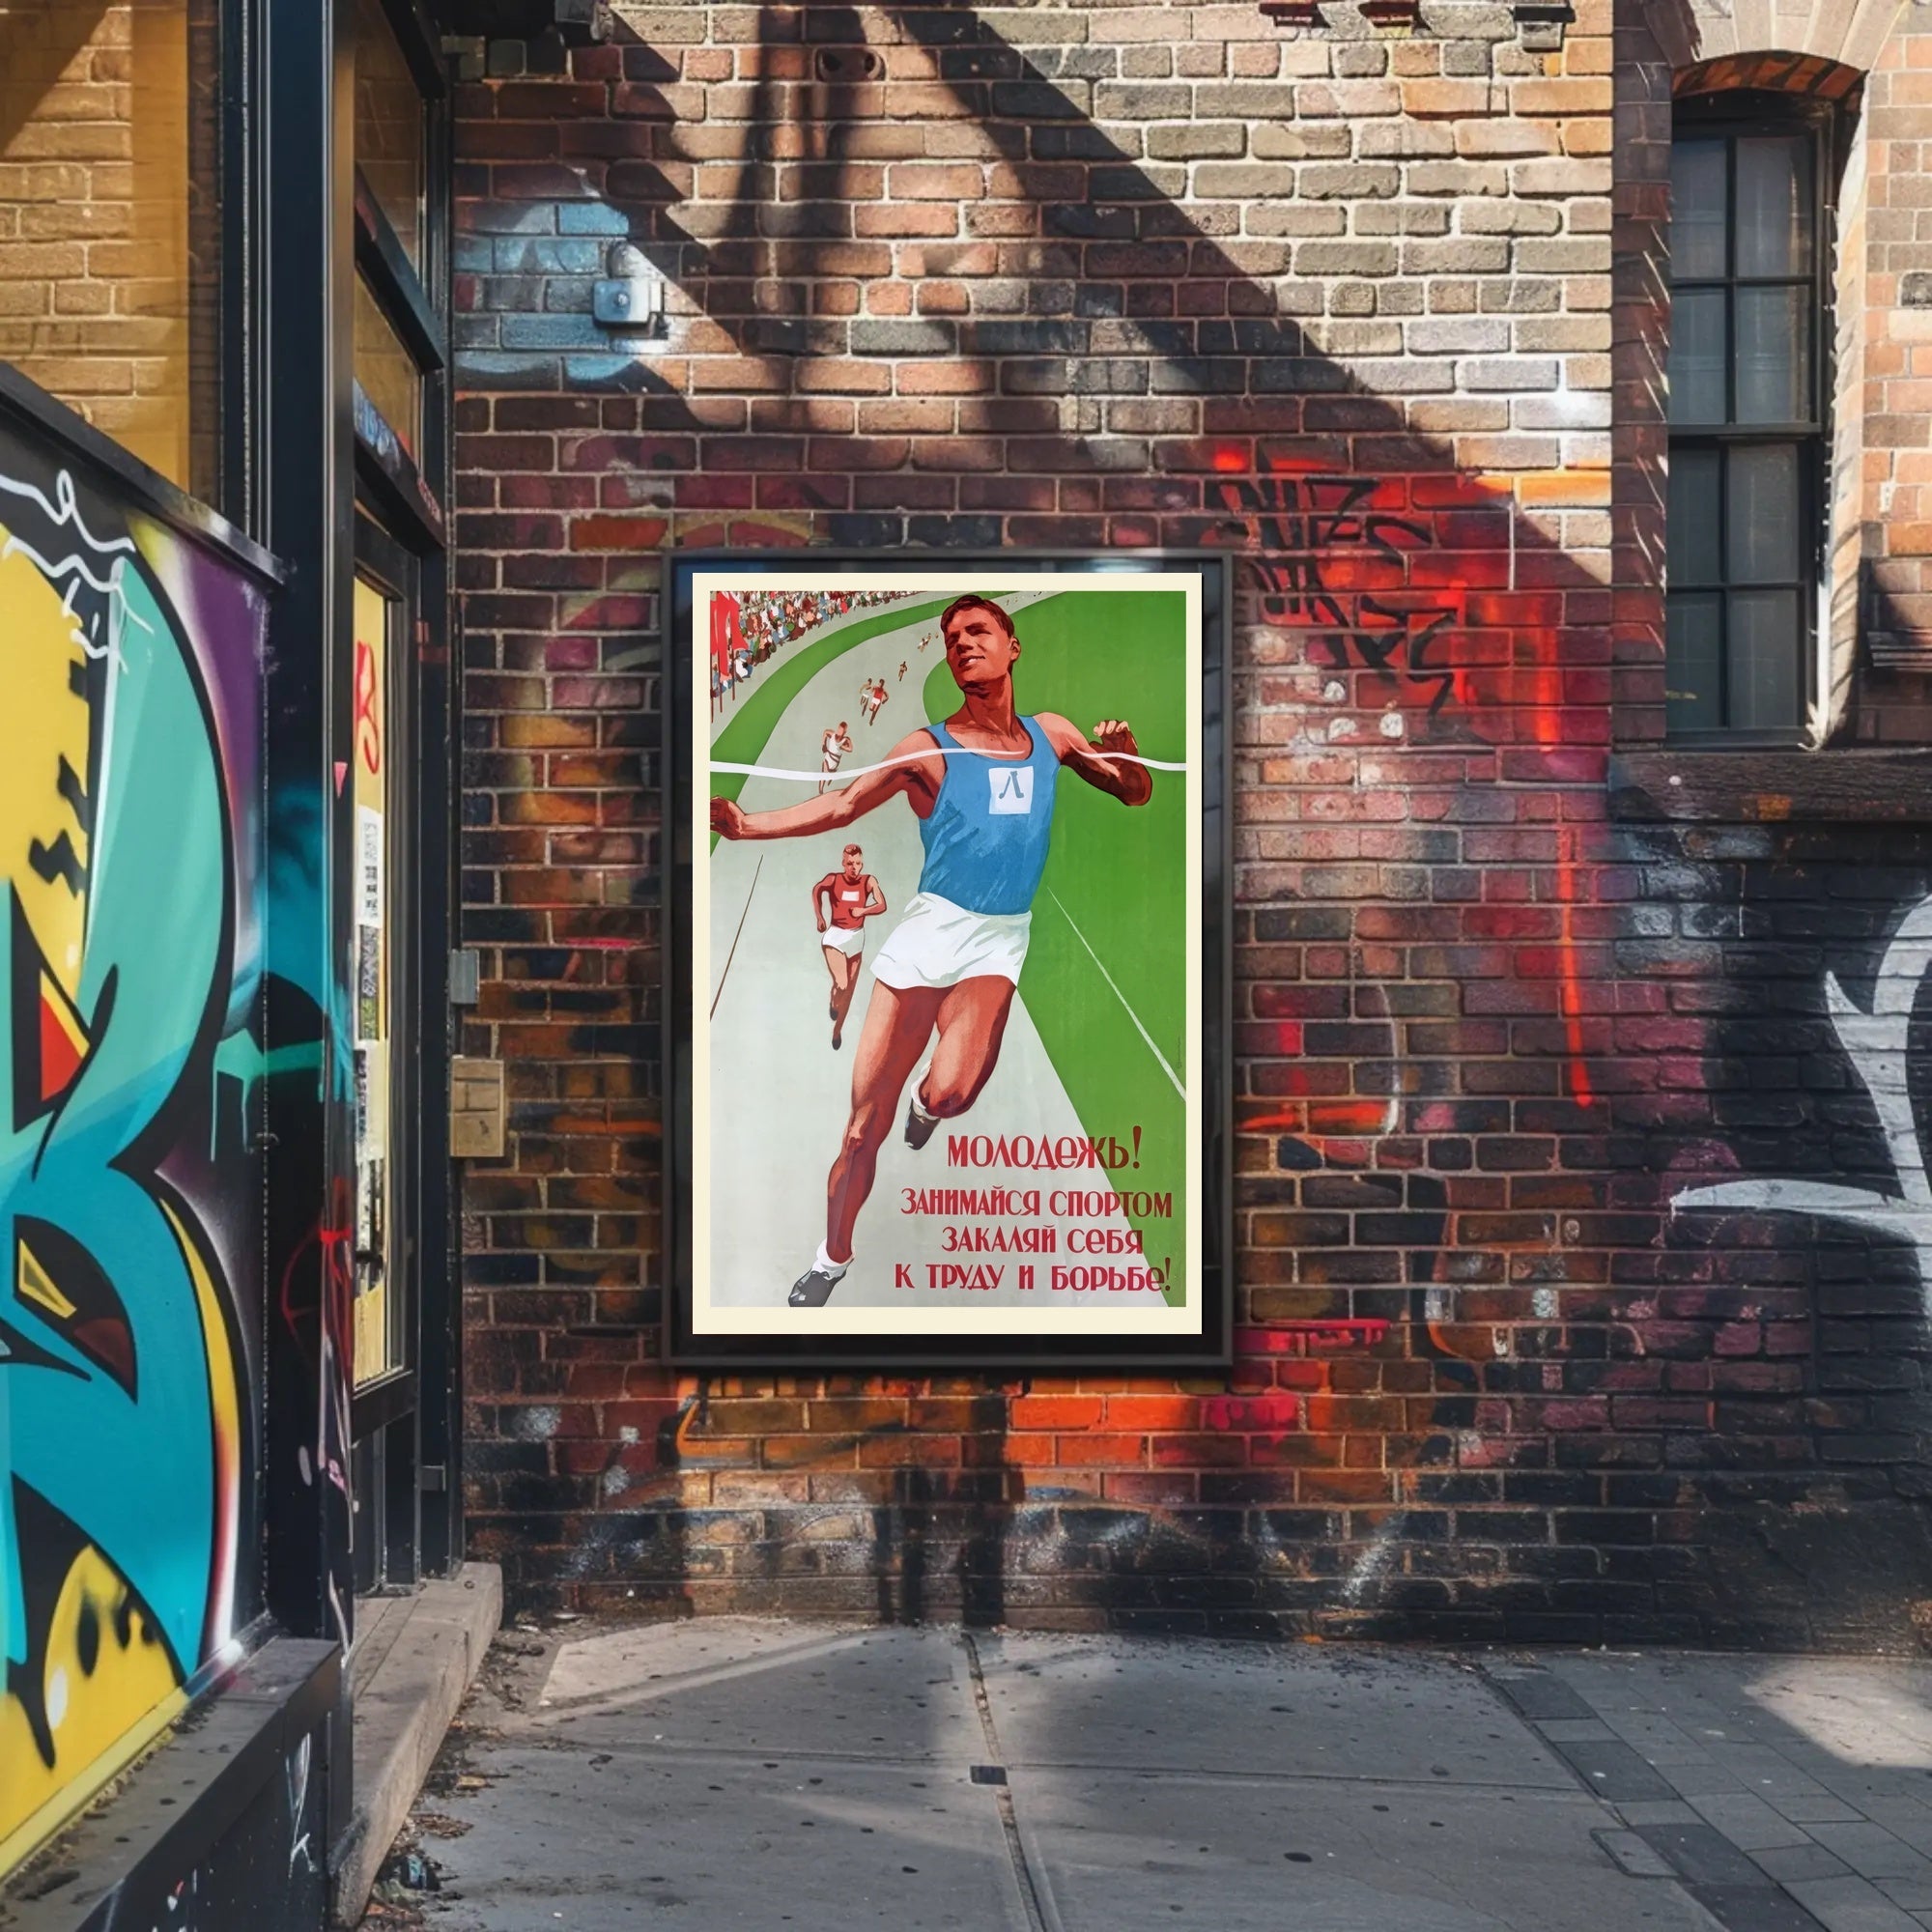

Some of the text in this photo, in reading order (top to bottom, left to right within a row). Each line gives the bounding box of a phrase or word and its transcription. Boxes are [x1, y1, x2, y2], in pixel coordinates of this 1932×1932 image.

[900, 1185, 1173, 1218] ЗАНИМАЙСЯ СПОРТОМ
[941, 1224, 1057, 1254] ЗАКАЛЯЙ
[895, 1264, 916, 1290] К
[925, 1264, 1006, 1291] ТРУДУ
[1018, 1264, 1035, 1291] И
